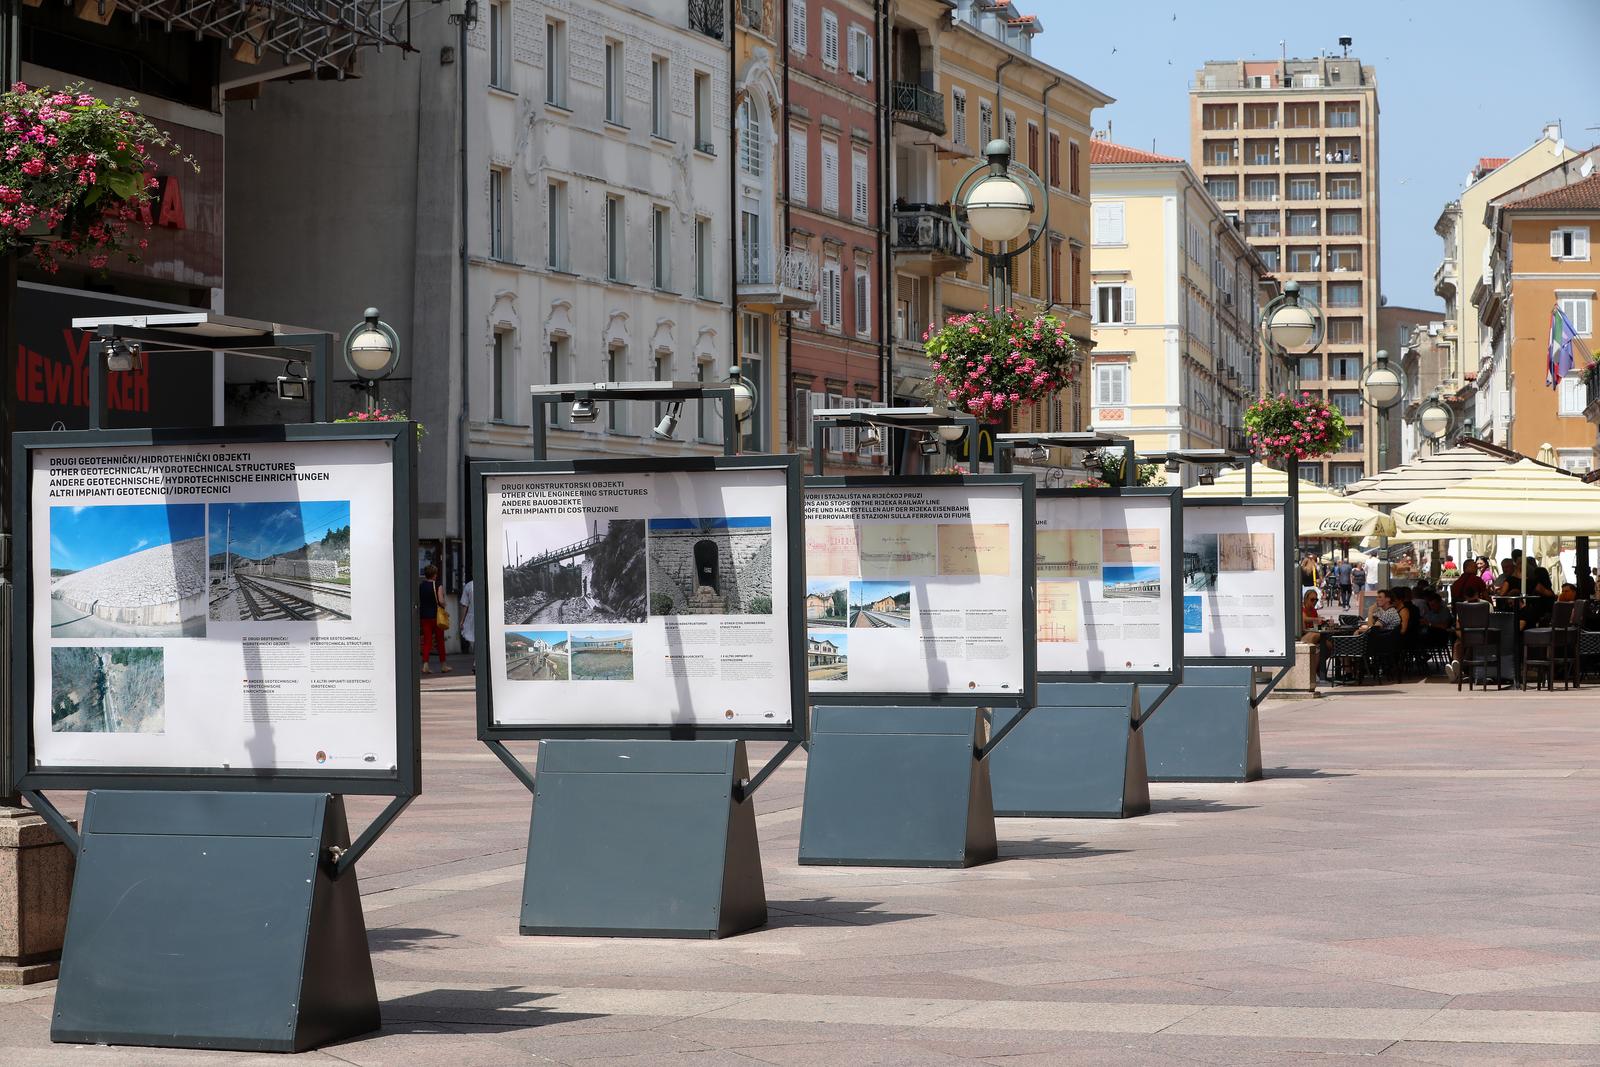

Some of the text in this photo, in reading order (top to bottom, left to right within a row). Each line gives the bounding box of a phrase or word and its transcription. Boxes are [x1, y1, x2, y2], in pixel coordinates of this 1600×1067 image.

[16, 328, 149, 413] NEWYKER
[50, 452, 250, 466] DRUGI GEOTEHNIČKI/HIDROTEHNIČKI OBJEKTI
[50, 462, 296, 476] OTHER GEOTECHNICAL/HYDROTECHNICAL STRUCTURES
[50, 472, 330, 486] ANDERE GEOTECHNISCHE/HYDROTECHNISCHE EINRICHTUNGEN
[50, 486, 230, 497] ALTRI IMPIANTI GEOTECNICI/IDROTECNICI
[501, 483, 524, 491] DRUGI
[525, 482, 591, 490] KONSTRUKTORSKI
[547, 490, 597, 498] ENGINEERING
[502, 498, 582, 507] ANDERE BAUOBJEKTE
[524, 507, 556, 515] IMPIANTI
